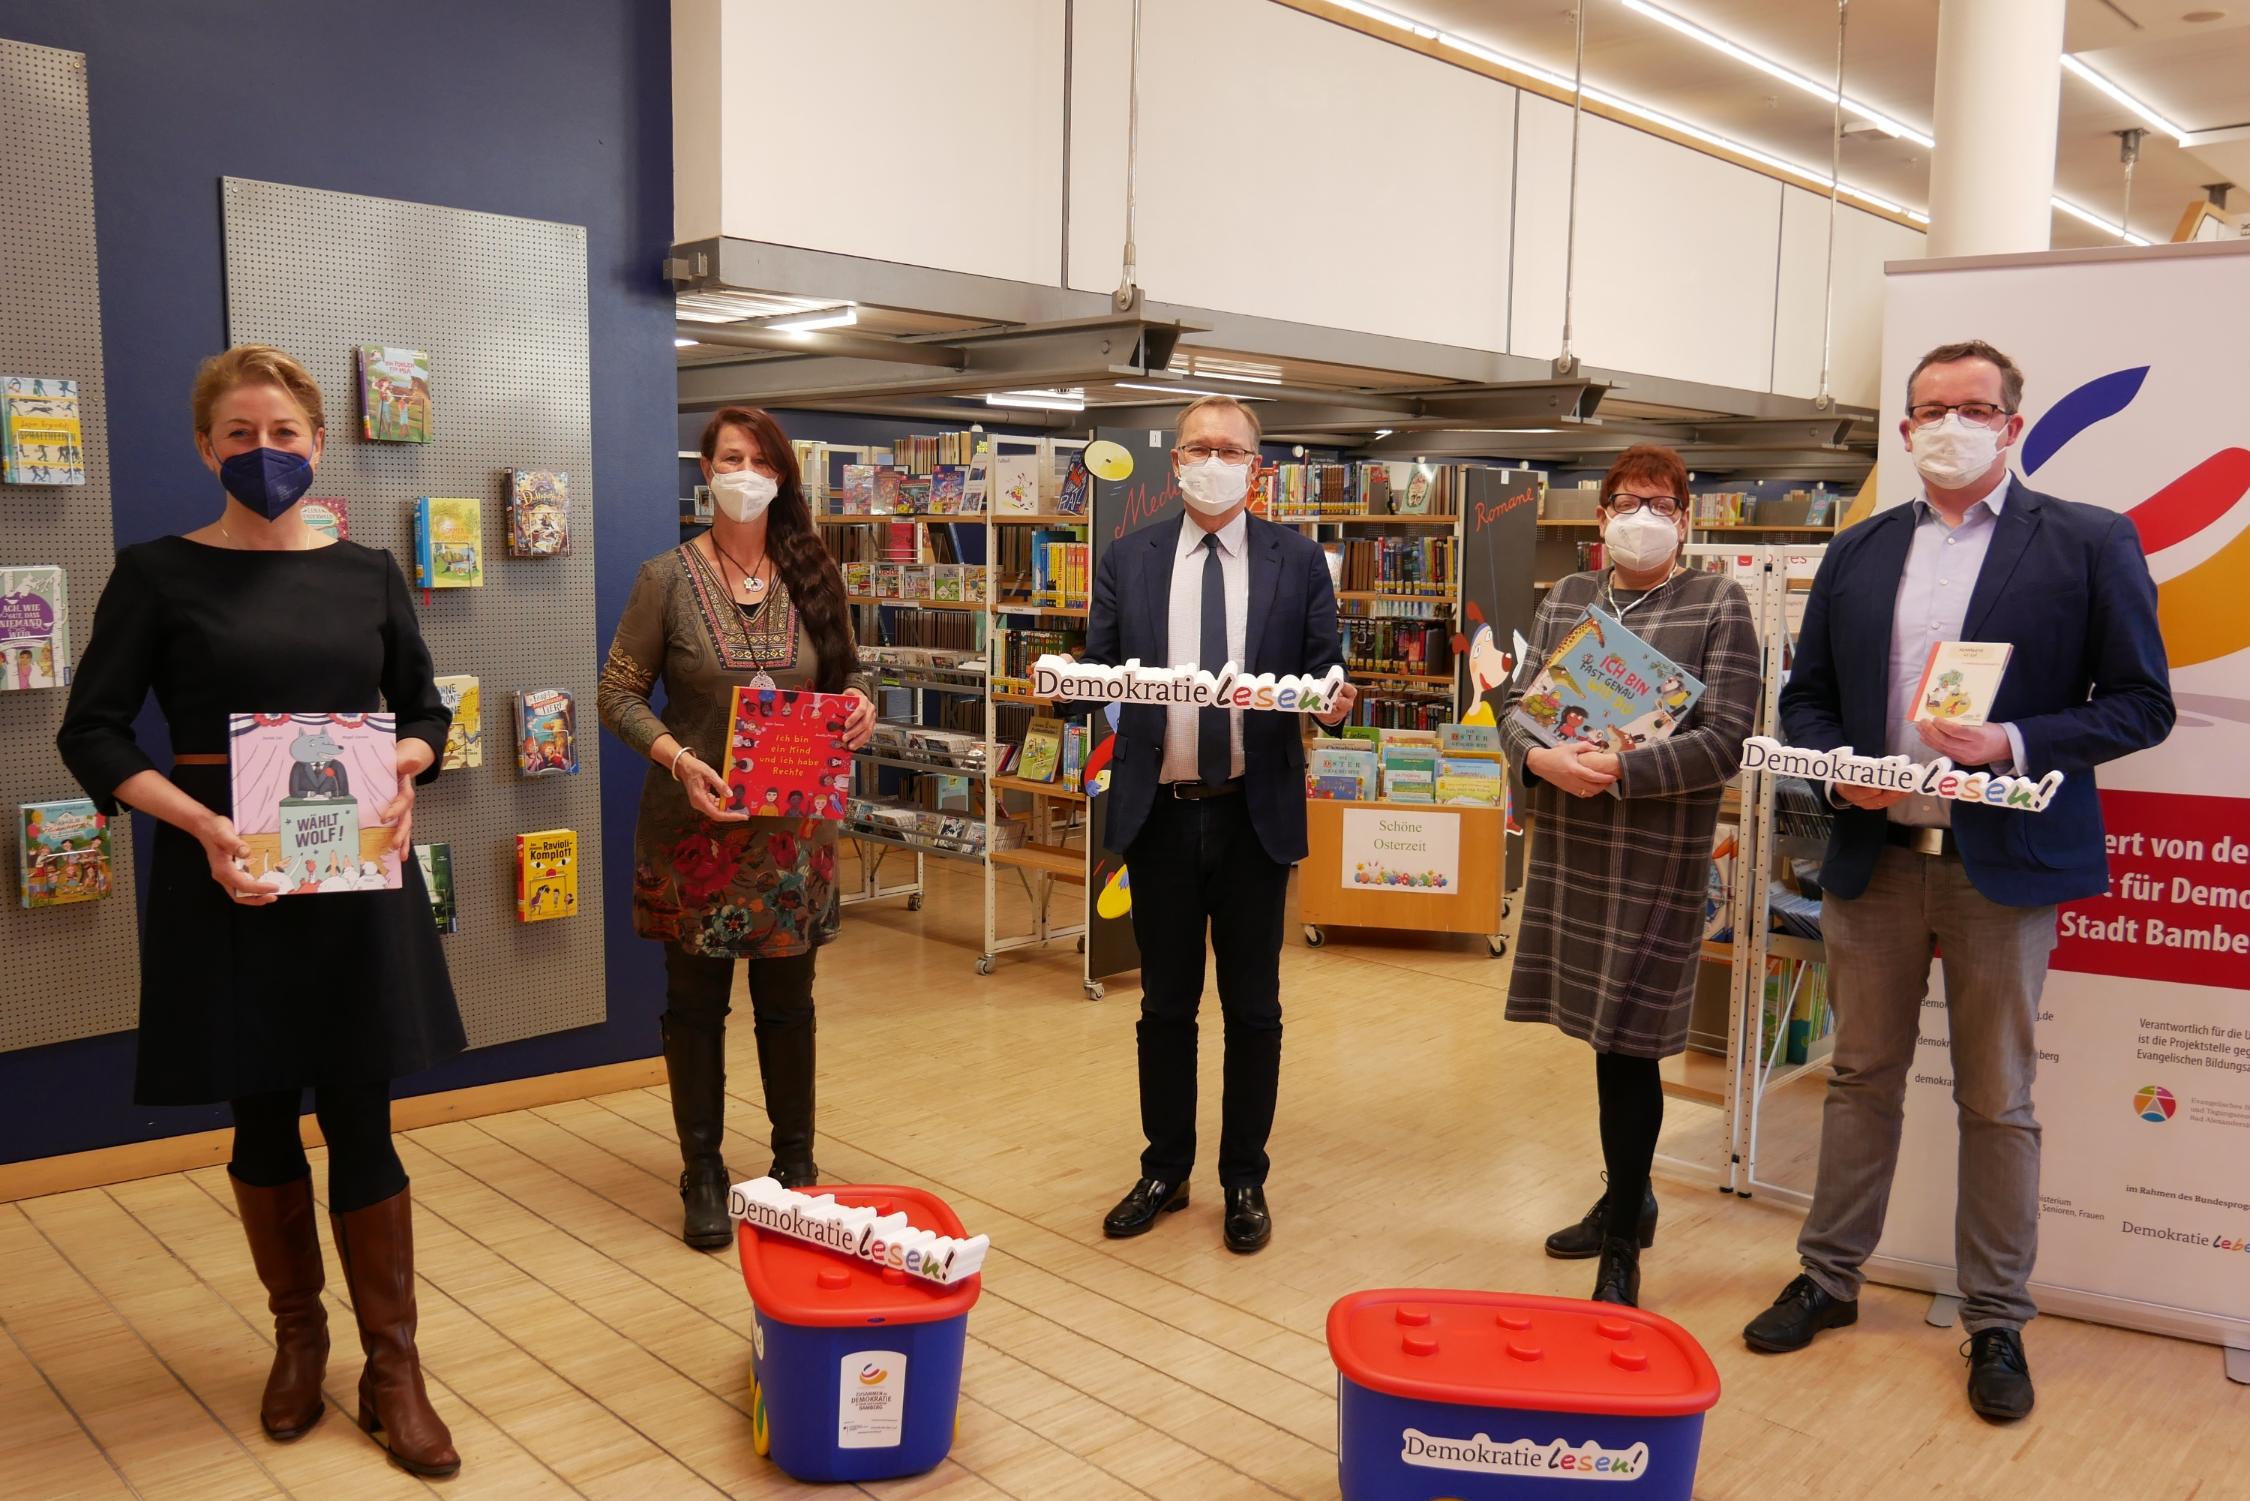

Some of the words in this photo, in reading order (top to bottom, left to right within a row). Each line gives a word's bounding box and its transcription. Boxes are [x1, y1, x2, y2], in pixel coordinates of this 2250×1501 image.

[1475, 488, 1536, 532] Romane
[23, 604, 40, 612] WIE
[1580, 662, 1605, 681] FAST
[1605, 678, 1636, 700] GENAU
[1599, 655, 1627, 680] ICH
[1624, 672, 1651, 697] BIN
[1036, 670, 1207, 703] Demokratie
[775, 735, 790, 743] Ich
[789, 746, 811, 754] Kind
[760, 756, 776, 764] und
[780, 757, 794, 765] ich
[797, 757, 819, 766] habe
[1743, 743, 1912, 789] Demokratie
[772, 767, 804, 776] Rechte
[297, 813, 340, 832] WÄHLT
[1379, 820, 1423, 834] Schöne
[530, 847, 571, 861] Komplott
[543, 840, 573, 851] Ravioli-
[1373, 839, 1426, 852] Osterzeit
[2105, 832, 2144, 856] ert
[2150, 837, 2203, 861] von
[2211, 836, 2250, 864] de
[2119, 872, 2165, 901] für
[2171, 877, 2250, 910] Demo
[2060, 911, 2139, 944] Stadt
[2145, 918, 2250, 954] Bambe
[1921, 998, 1948, 1009] demo
[2139, 1017, 2209, 1036] Verantwortlich
[2211, 1026, 2225, 1037] für
[2227, 1028, 2242, 1040] die
[1917, 1036, 1950, 1048] demokr
[2039, 1050, 2060, 1063] berg
[2138, 1034, 2150, 1044] ist
[2152, 1035, 2167, 1046] die
[2169, 1037, 2231, 1054] Projektstelle
[2233, 1046, 2250, 1058] geg
[2136, 1048, 2203, 1066] Evangelischen
[2039, 1195, 2072, 1206] isterium
[2126, 1184, 2138, 1193] im
[2139, 1186, 2177, 1199] Rahmen
[2178, 1191, 2193, 1202] des
[731, 1191, 853, 1250] Demokratie
[2042, 1204, 2077, 1217] Senioren,
[2078, 1209, 2105, 1220] Frauen
[2121, 1221, 2209, 1246] Demokratie
[1406, 1436, 1542, 1468] Demokratie
